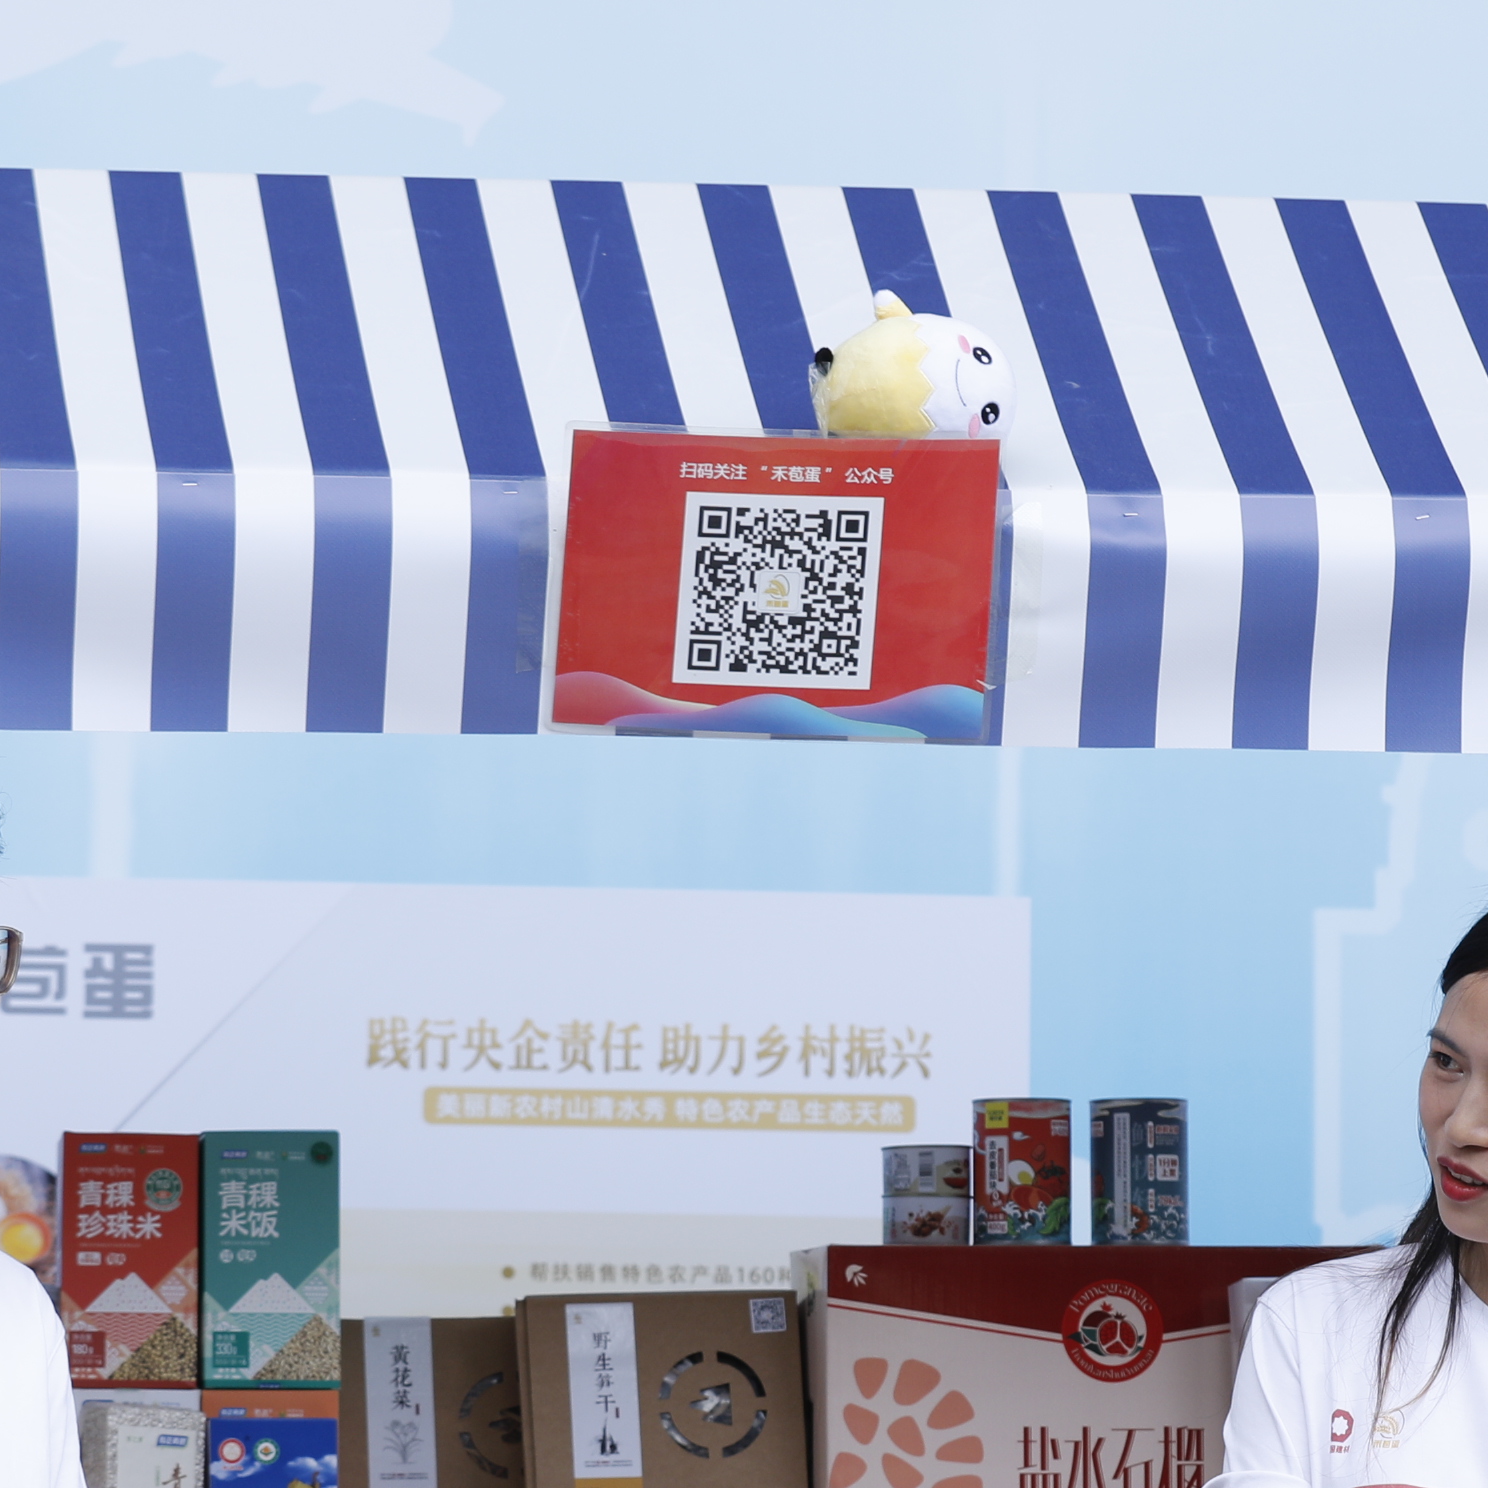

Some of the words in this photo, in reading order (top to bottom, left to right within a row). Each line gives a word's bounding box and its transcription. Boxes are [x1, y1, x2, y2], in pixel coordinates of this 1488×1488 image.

[679, 462, 748, 481] 扫码关注
[844, 467, 895, 484] 公众号
[367, 1015, 644, 1074] 践行央企责任
[658, 1023, 933, 1080] 助力乡村振兴
[674, 1096, 905, 1127] 特色农产品生态天然
[76, 1180, 136, 1208] 青稞
[218, 1180, 281, 1209] 青稞
[75, 1210, 163, 1239] 珍珠米
[218, 1209, 280, 1238] 米饭
[389, 1344, 413, 1411] 黄花菜
[592, 1331, 617, 1414] 野生笋干
